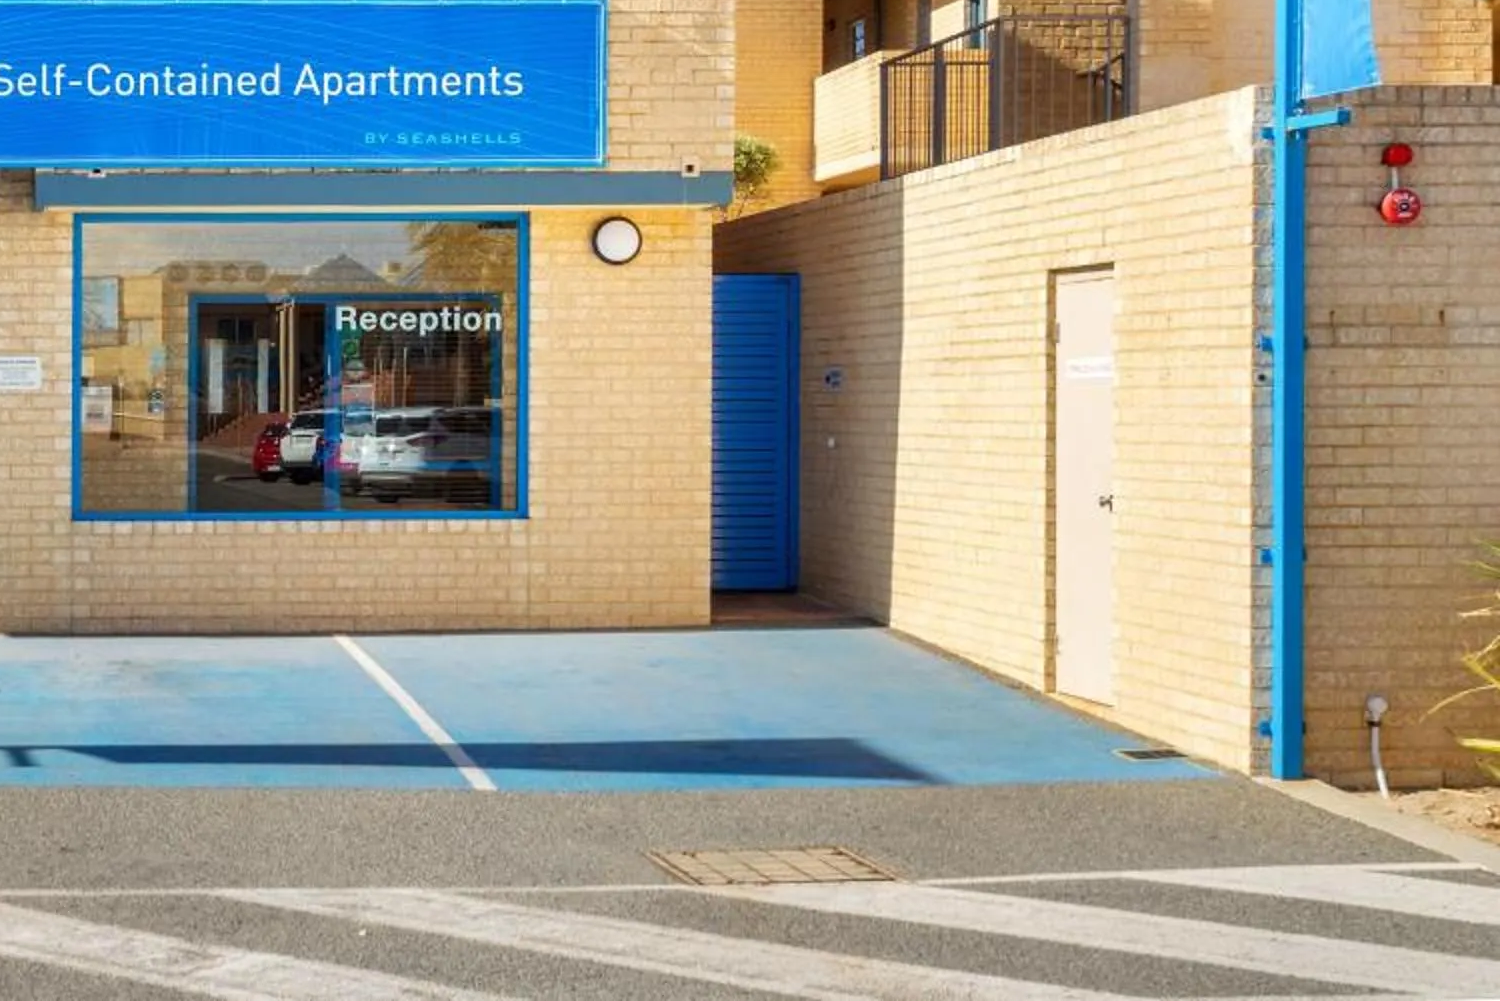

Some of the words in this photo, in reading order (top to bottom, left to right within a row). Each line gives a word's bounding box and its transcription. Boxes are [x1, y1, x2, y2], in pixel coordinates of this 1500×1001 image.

[293, 62, 523, 104] Apartments
[365, 132, 389, 144] BY
[396, 131, 522, 145] SEASHELLS
[335, 306, 502, 336] Reception
